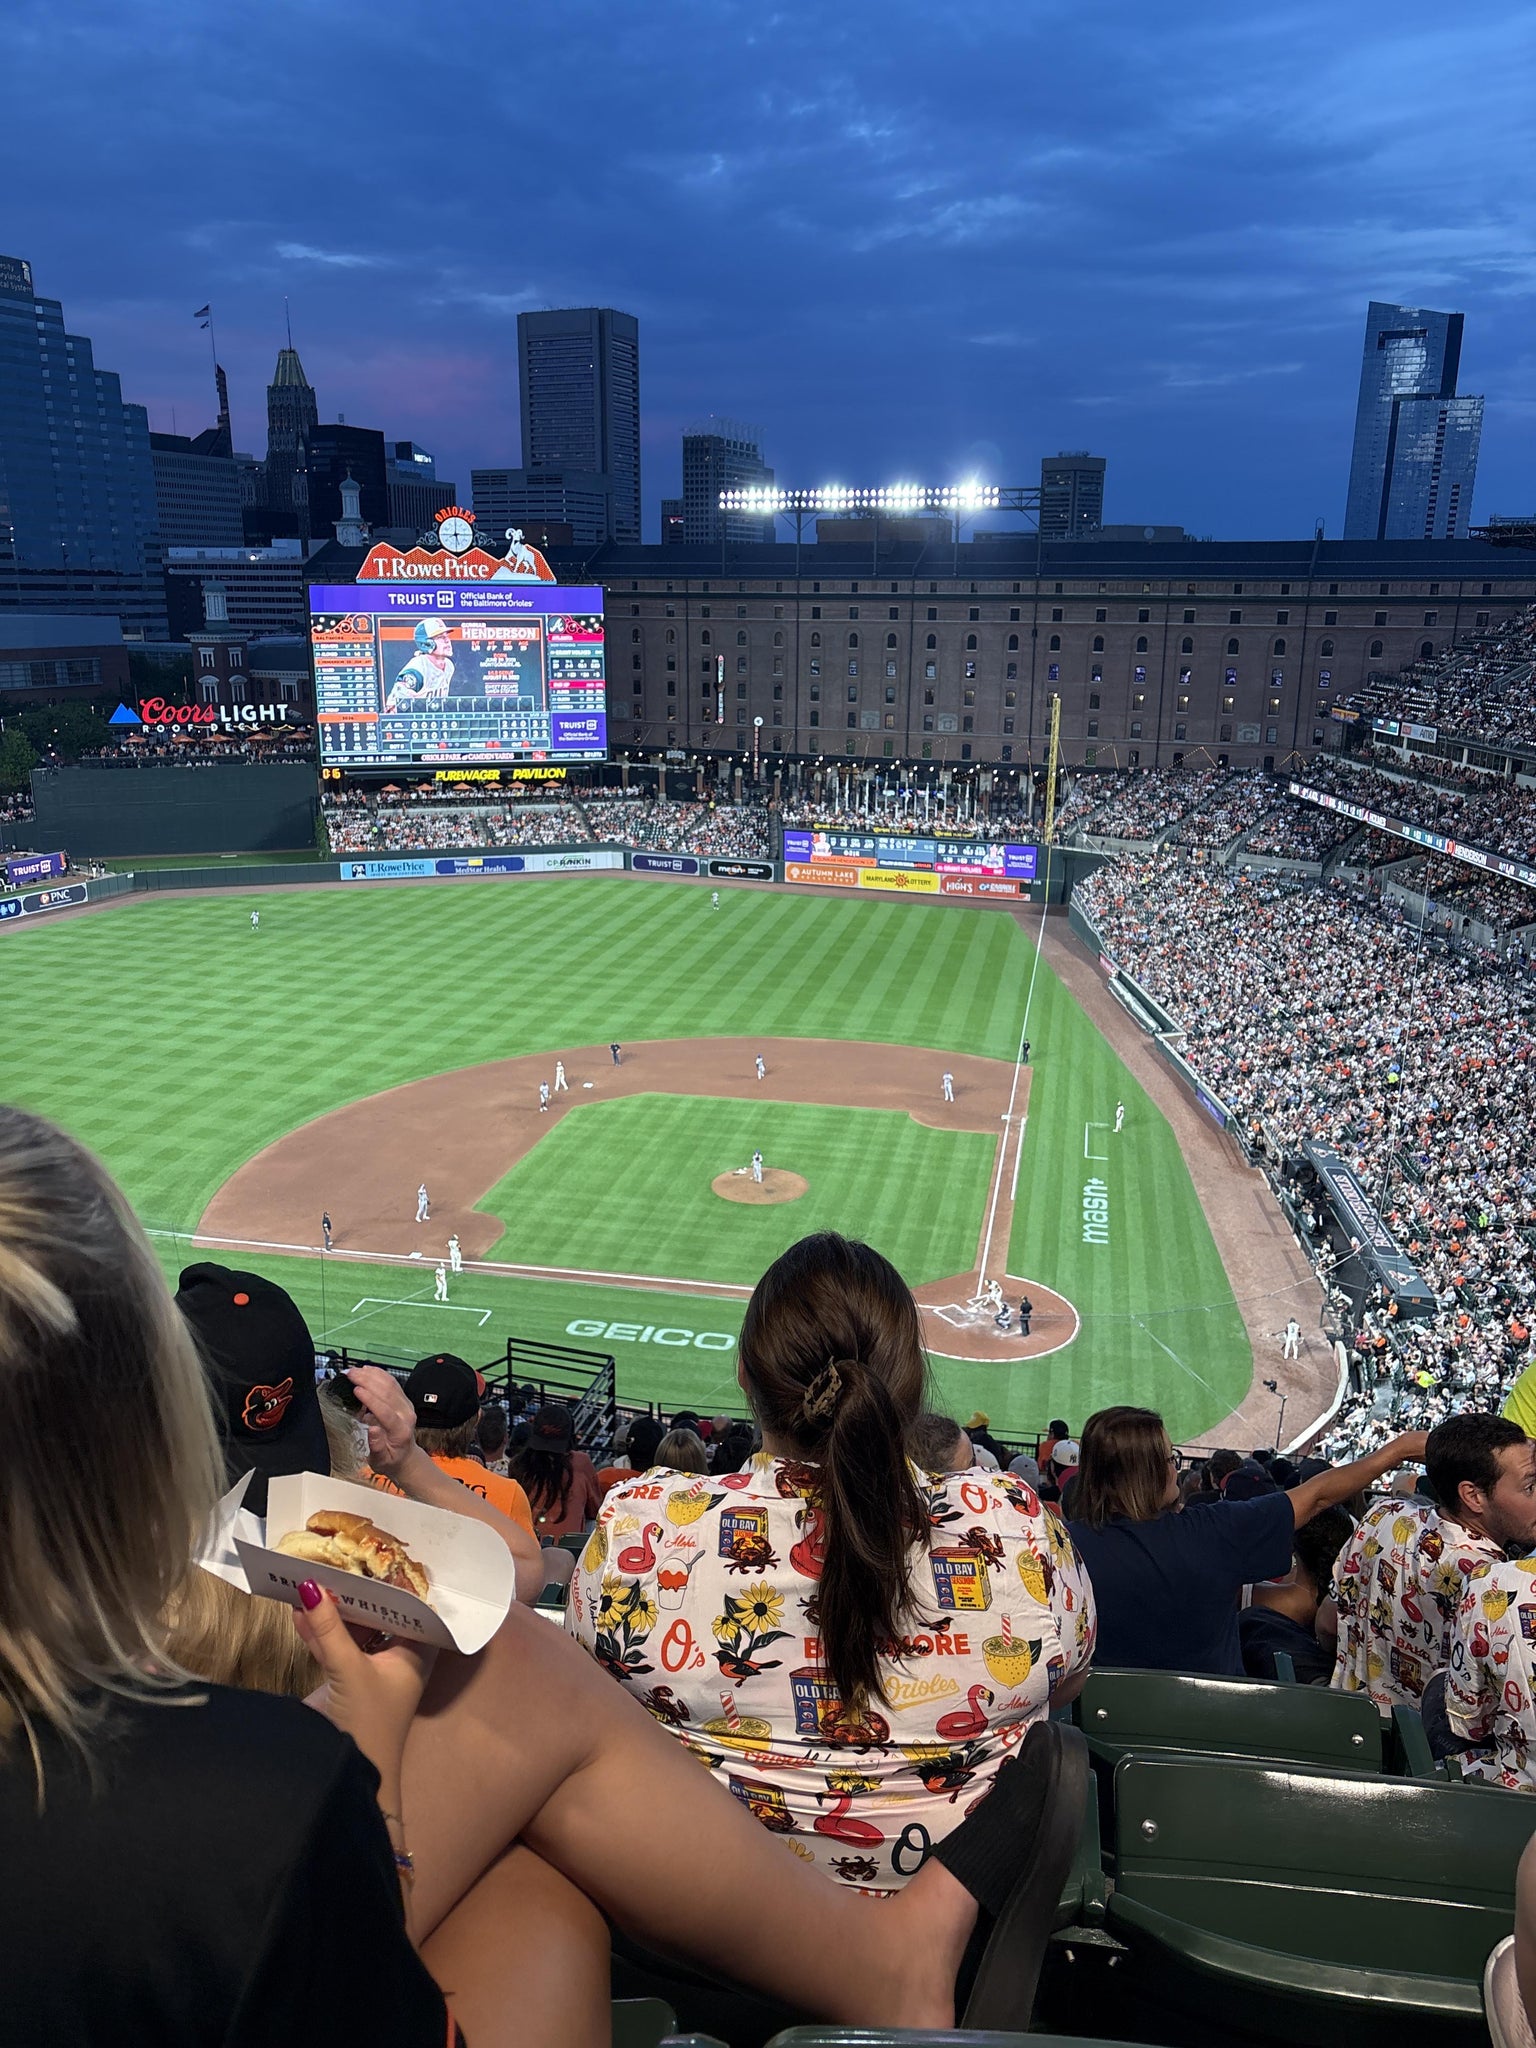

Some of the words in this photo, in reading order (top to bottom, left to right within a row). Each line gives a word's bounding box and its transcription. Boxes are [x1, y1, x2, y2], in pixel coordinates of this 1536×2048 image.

[434, 506, 477, 524] ORIOLES
[445, 558, 490, 578] Price
[388, 593, 435, 605] TRUIST
[460, 592, 486, 600] Official
[486, 592, 504, 600] Bank
[505, 592, 513, 600] of
[460, 599, 473, 607] the
[473, 599, 507, 608] Baltimore
[507, 600, 533, 608] Orioles
[462, 627, 536, 640] HENDERSON
[139, 697, 216, 724] Coors
[220, 703, 289, 722] LIGHT
[142, 723, 194, 733] ROOF
[210, 723, 260, 732] DECK
[559, 721, 586, 729] TRUIST
[435, 769, 501, 781] PUREWAGER
[512, 767, 566, 780] PAVILION
[1455, 844, 1488, 866] HENDERSON
[13, 864, 40, 876] TRUIST
[455, 866, 483, 874] MedStar
[484, 864, 507, 873] Health
[648, 859, 672, 868] TRUIST
[835, 870, 854, 879] LAKE
[866, 875, 894, 883] MARYLAND
[907, 878, 931, 886] LOTTERY
[946, 881, 973, 893] HIGH'S
[50, 889, 70, 902] PNC
[565, 1319, 736, 1351] GEICO
[960, 1482, 1003, 1514] O's
[721, 1518, 738, 1529] OLD
[739, 1520, 756, 1531] BAY
[664, 1533, 697, 1549] Aloha
[934, 1563, 953, 1575] OLD
[954, 1563, 973, 1576] BAY
[340, 1594, 424, 1630] WHISTLE
[660, 1618, 706, 1673] O's
[795, 1684, 820, 1699] OLD
[885, 1673, 960, 1703] Orioles
[998, 1695, 1033, 1711] Aloha
[1504, 1680, 1531, 1713] O's
